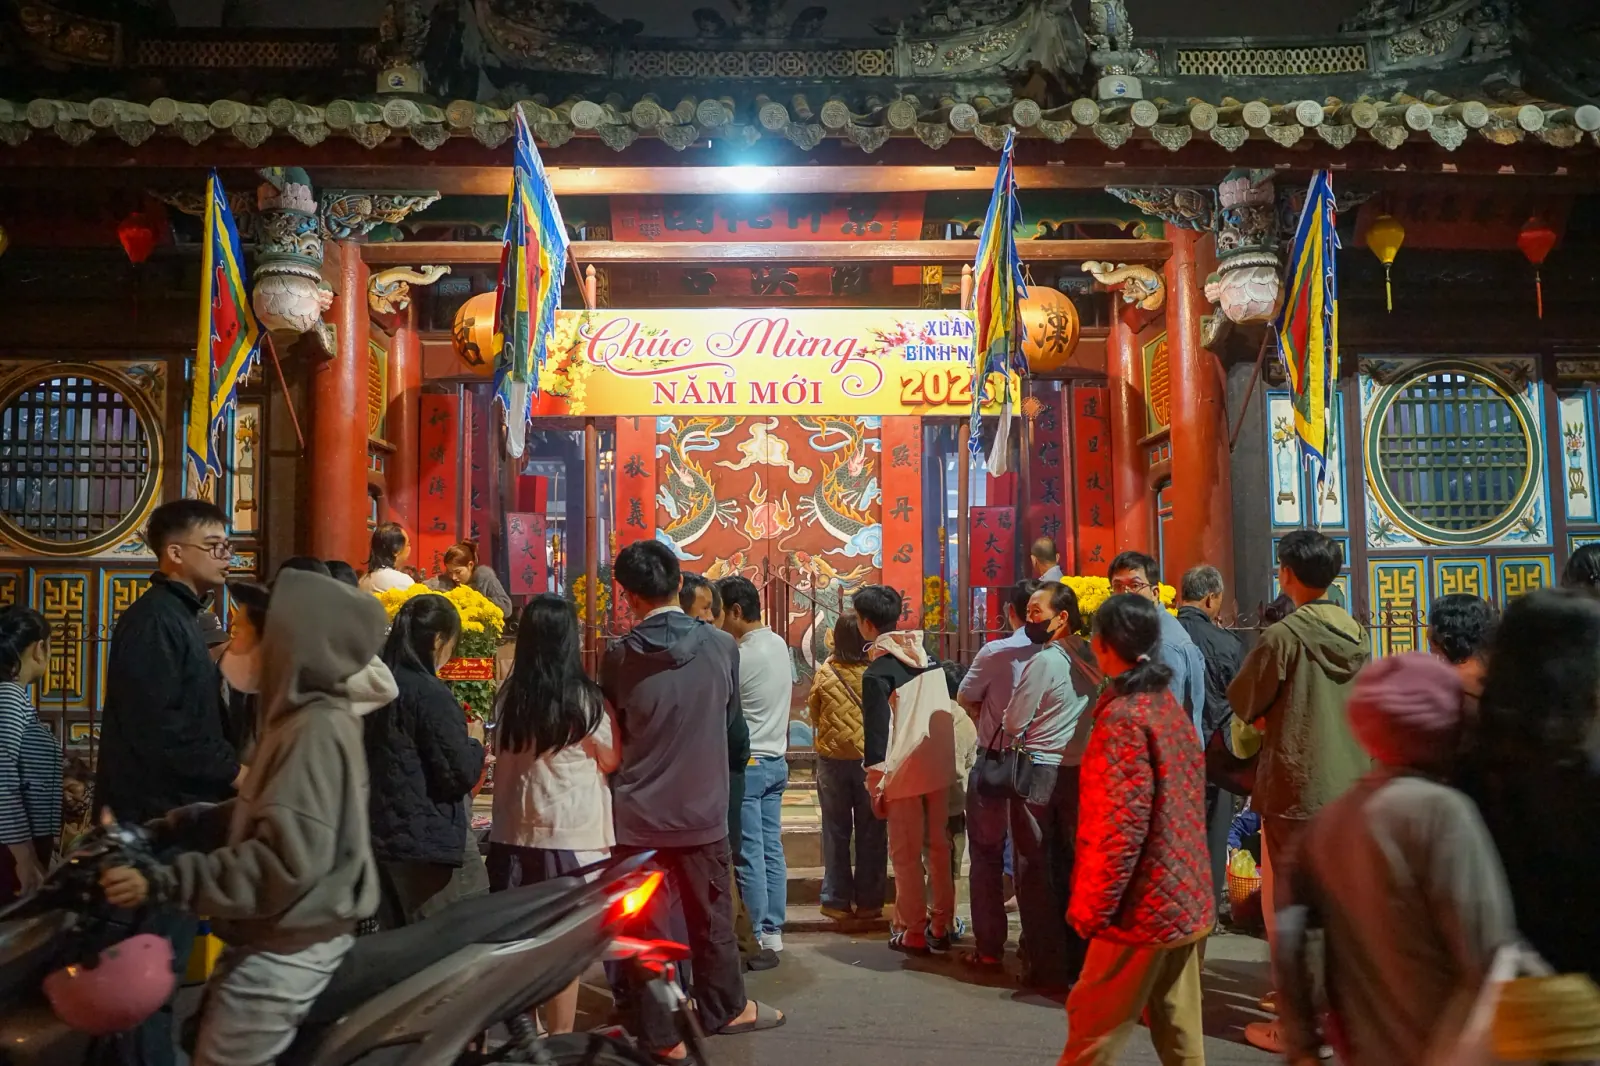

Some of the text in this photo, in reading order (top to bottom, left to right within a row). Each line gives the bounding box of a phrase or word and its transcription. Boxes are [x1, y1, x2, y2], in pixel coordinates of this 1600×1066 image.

[927, 317, 975, 336] XUÂN
[580, 317, 883, 396] Chúc Mừng
[906, 342, 951, 361] BÍNH
[652, 377, 822, 405] NĂM MỚI
